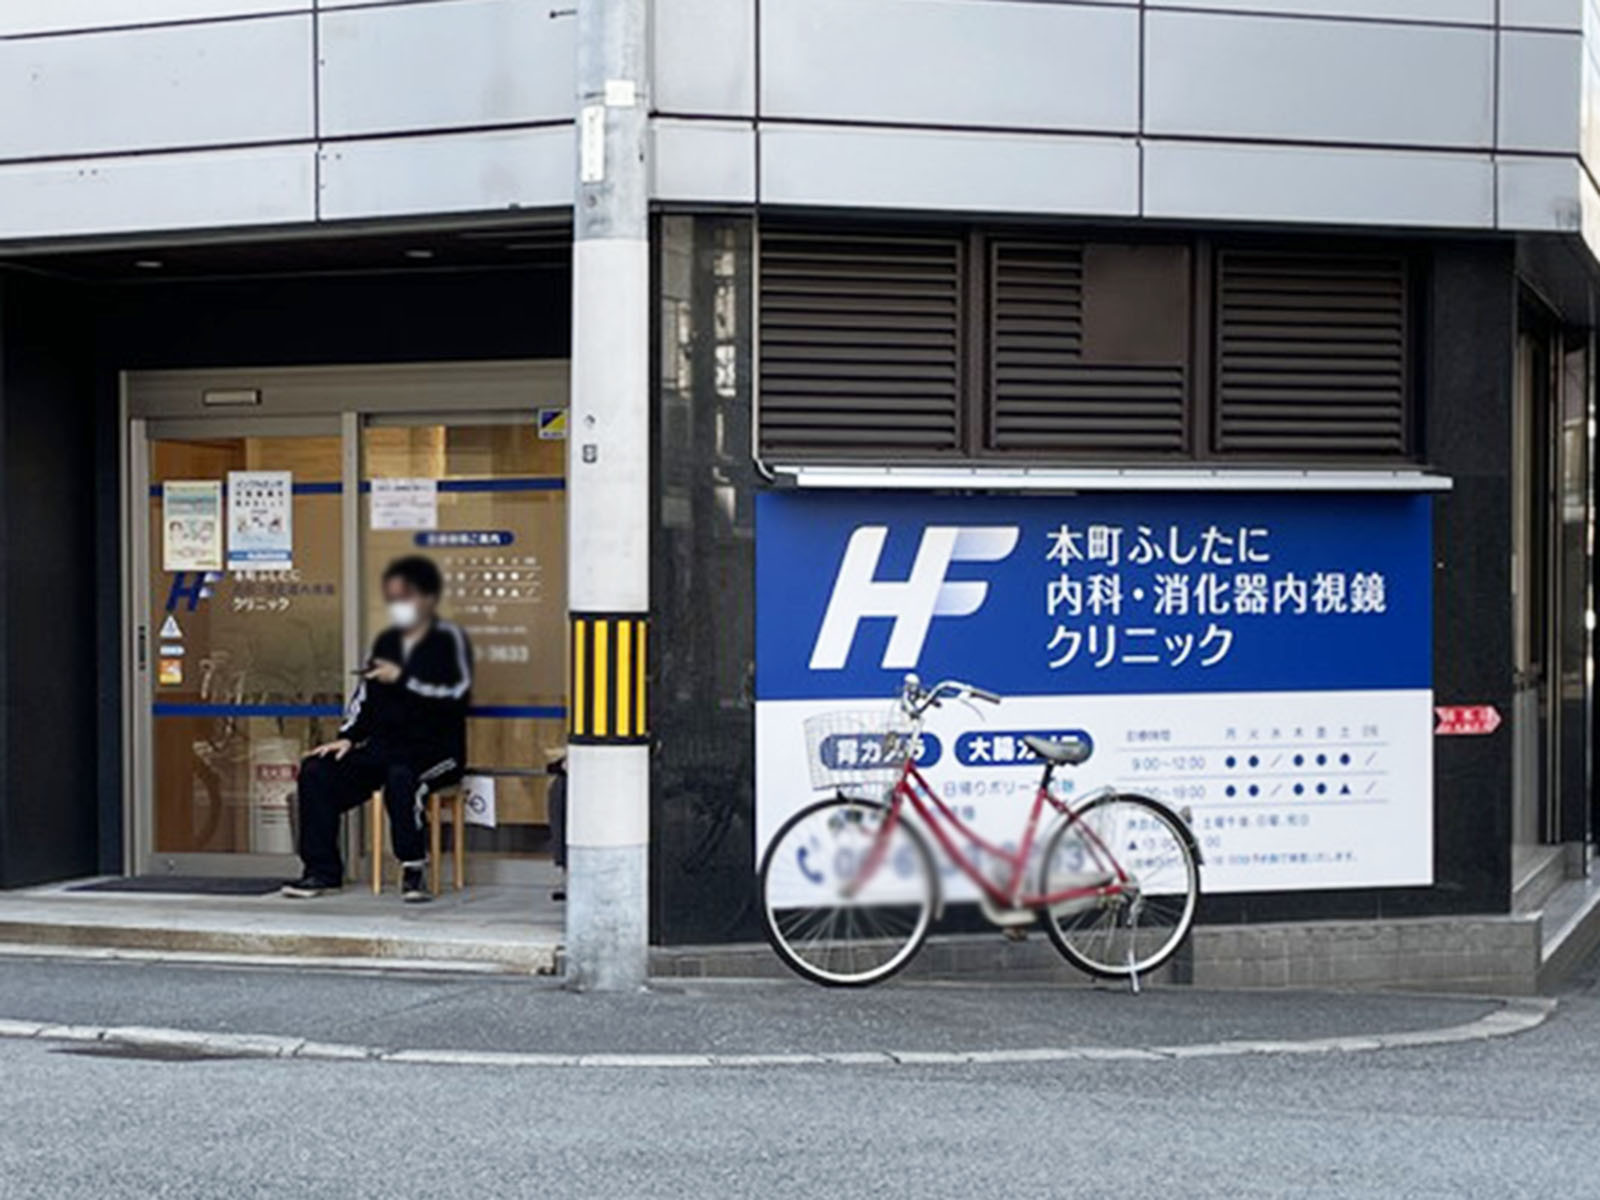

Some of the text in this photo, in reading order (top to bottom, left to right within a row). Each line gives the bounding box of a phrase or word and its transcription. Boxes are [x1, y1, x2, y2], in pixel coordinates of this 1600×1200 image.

[1046, 524, 1271, 566] 本町ふしたに
[808, 525, 1020, 669] HF
[1047, 572, 1387, 616] 内科・消化器内視鏡
[1047, 623, 1233, 668] クリニック
